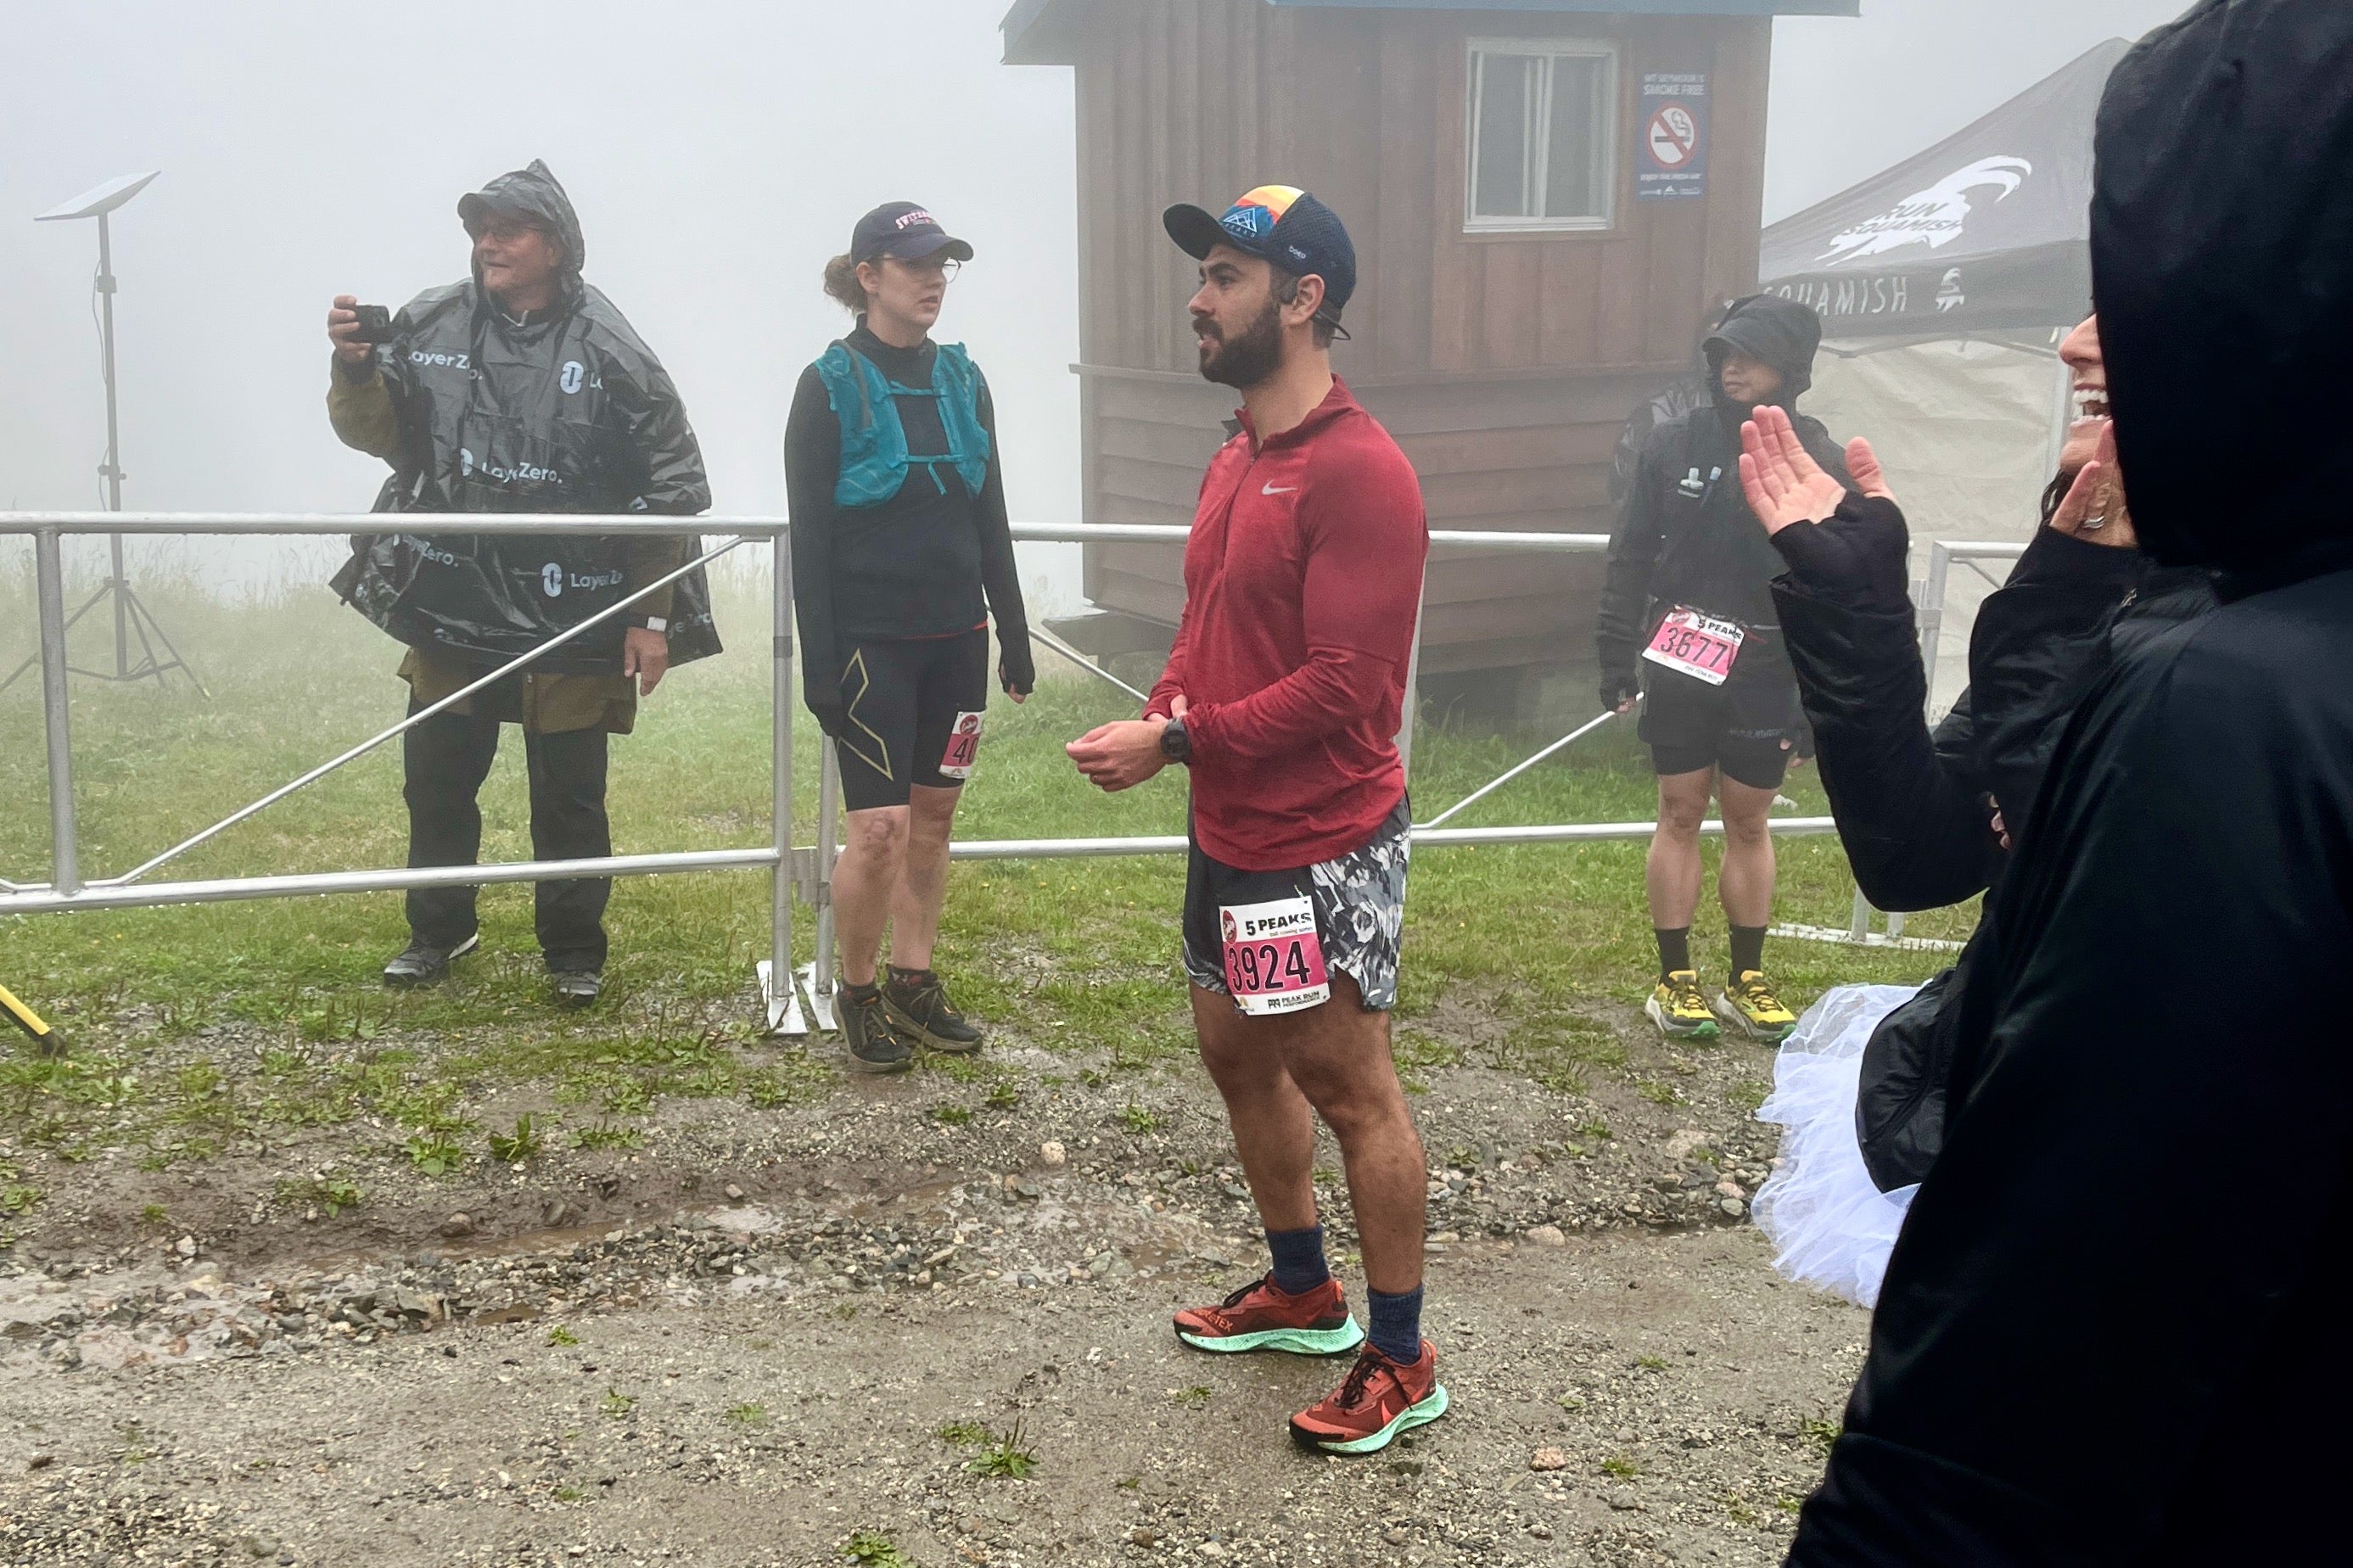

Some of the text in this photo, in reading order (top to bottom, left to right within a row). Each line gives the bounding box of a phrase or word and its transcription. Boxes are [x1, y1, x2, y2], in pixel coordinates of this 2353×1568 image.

[1643, 84, 1705, 96] SMOKE FREE
[1764, 276, 1907, 316] UAMISH
[1661, 627, 1728, 668] 3677
[1245, 912, 1312, 936] 5 PEAKS
[1228, 941, 1311, 992] 3924
[1303, 990, 1319, 999] RUN
